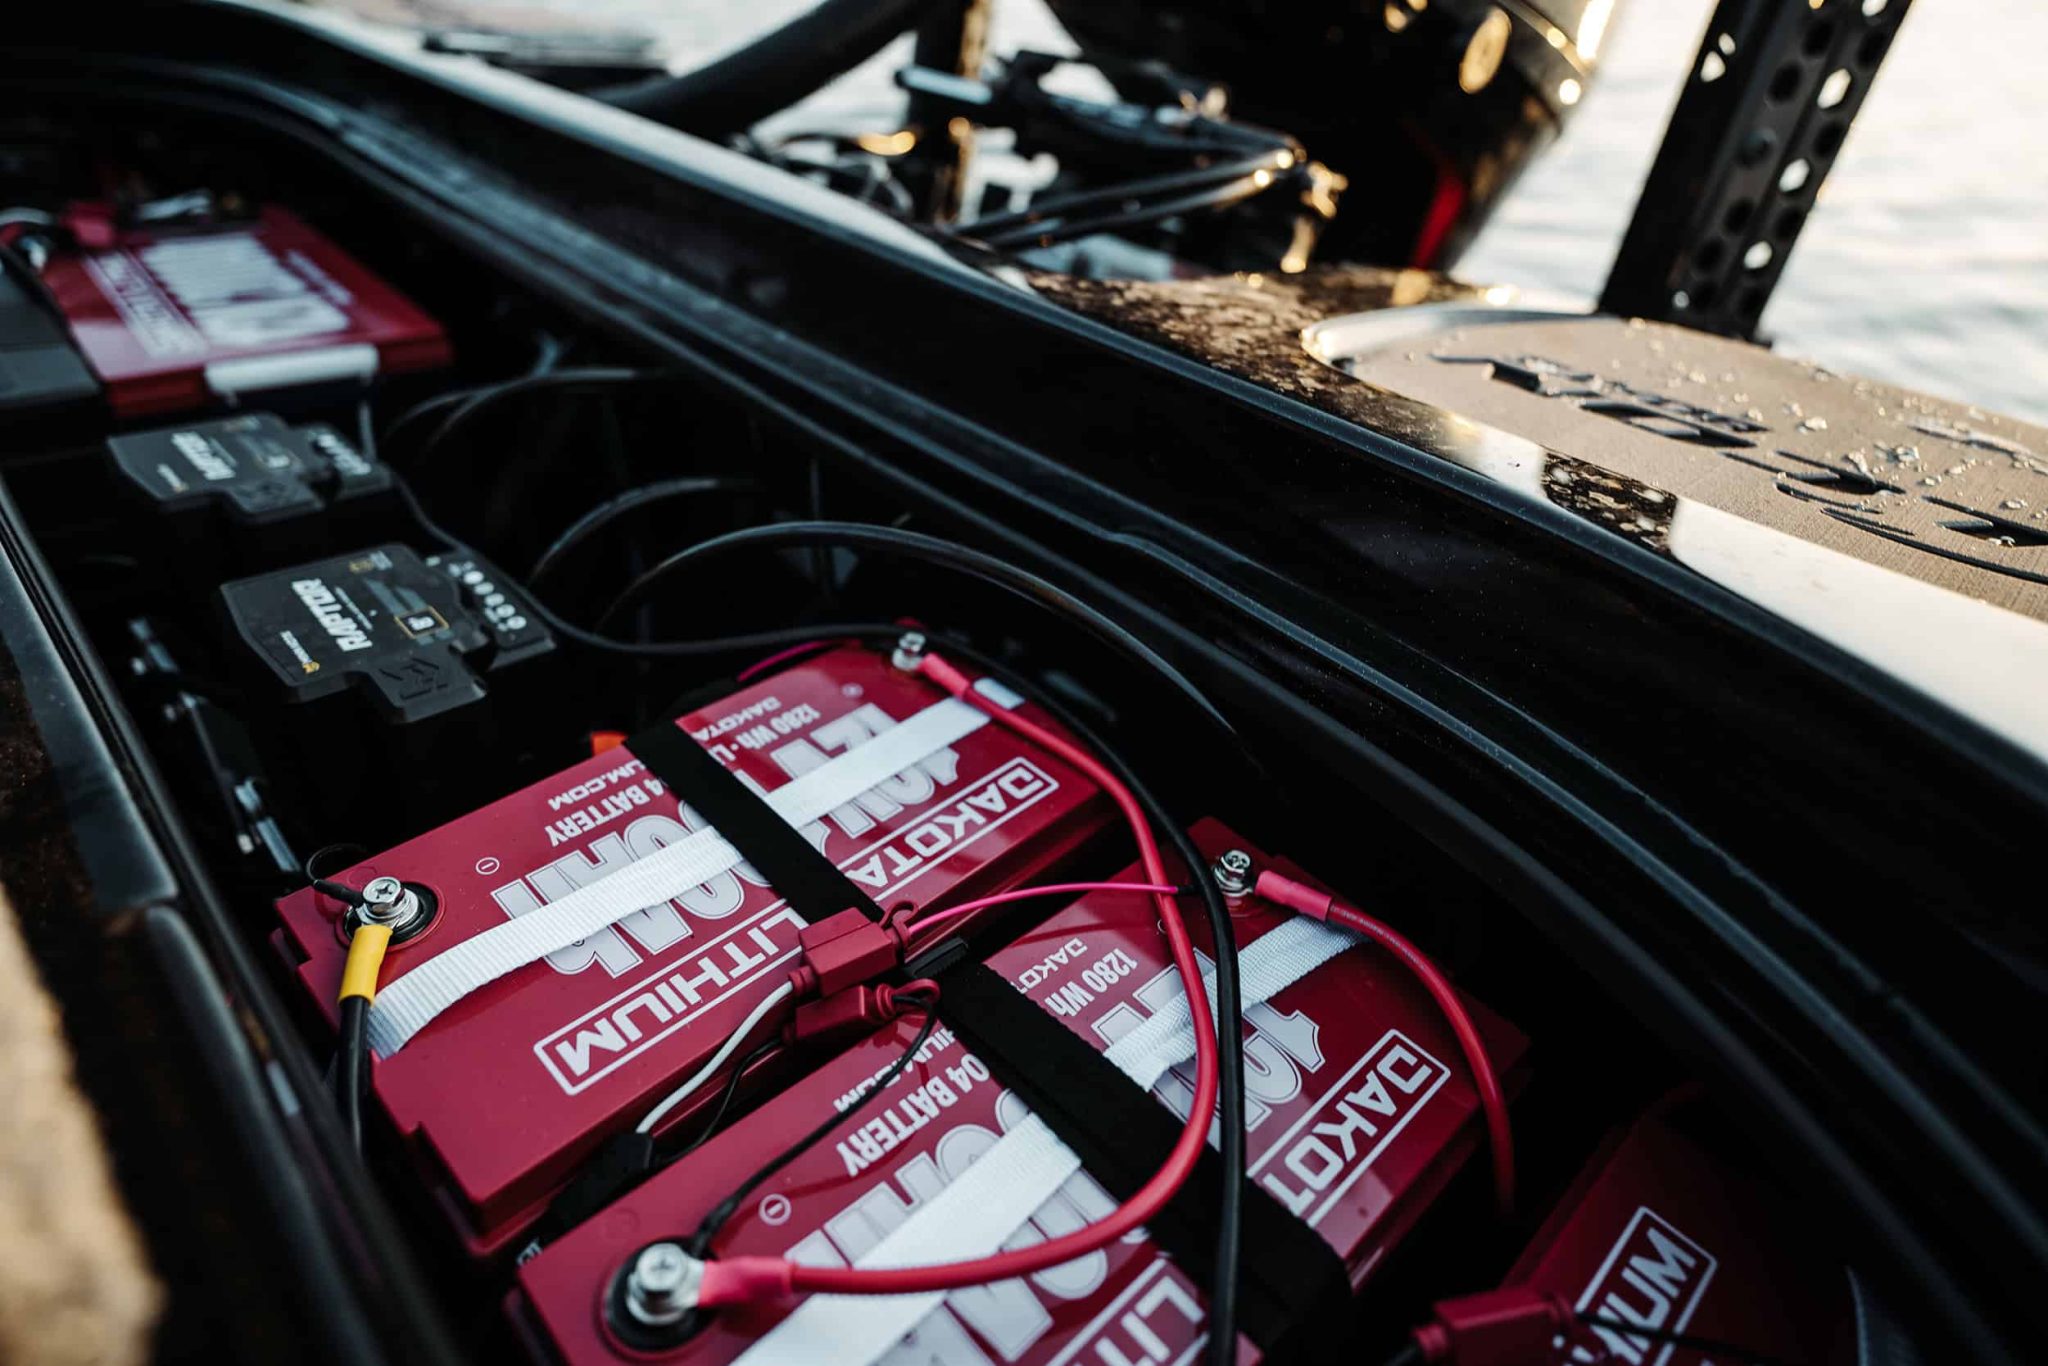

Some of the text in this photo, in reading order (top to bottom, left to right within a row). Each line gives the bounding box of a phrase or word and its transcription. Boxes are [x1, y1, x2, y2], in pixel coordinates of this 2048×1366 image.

[291, 578, 373, 652] RAPTOR
[736, 725, 779, 749] Wh
[770, 703, 821, 735] 1280
[545, 785, 650, 847] BATTERY
[555, 766, 1044, 1077] DAKOTA LITHIUM
[1010, 937, 1088, 994] DAKOT
[1082, 948, 1138, 993] 1280
[1044, 981, 1095, 1017] Wh
[836, 1076, 959, 1177] BATTERY
[1263, 1044, 1432, 1218] DAKOT
